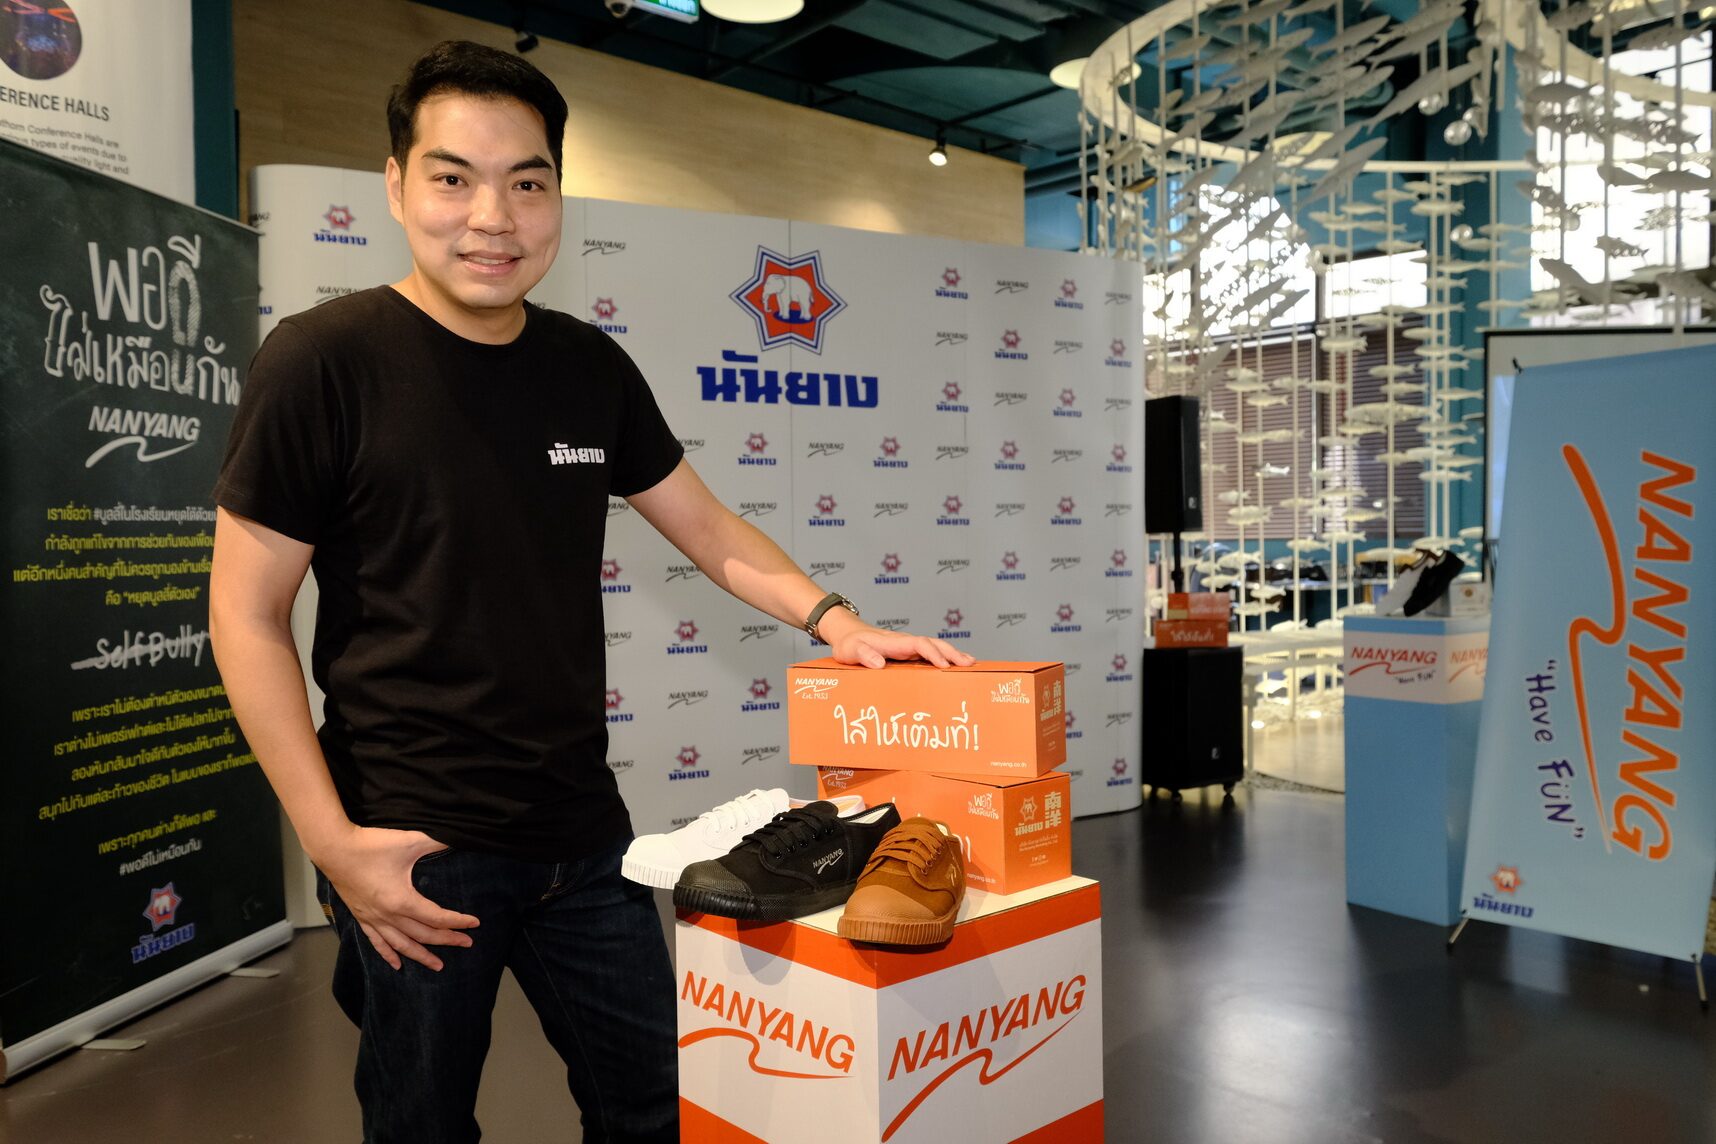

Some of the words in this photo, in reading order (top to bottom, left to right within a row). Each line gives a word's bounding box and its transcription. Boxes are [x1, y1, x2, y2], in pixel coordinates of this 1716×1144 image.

[65, 97, 110, 122] HALLS
[28, 124, 82, 140] Conference
[85, 132, 104, 146] Halls
[106, 138, 119, 149] are
[31, 138, 58, 151] types
[59, 142, 69, 152] of
[71, 144, 100, 157] events
[101, 148, 116, 160] due
[118, 153, 128, 162] to
[113, 165, 129, 176] and
[583, 239, 626, 250] NANYANG
[40, 284, 242, 406] ไม่เหมือนกัน
[697, 350, 878, 408] นันยาง
[88, 405, 201, 441] NANYANG
[548, 443, 605, 465] นันยาง
[808, 442, 845, 451] NANYANG
[739, 502, 778, 511] NANYANG
[811, 561, 846, 570] NANYANG
[741, 624, 779, 634] NANYANG
[1351, 646, 1438, 665] NANYANG
[1607, 449, 1698, 861] NANYANG
[795, 678, 839, 686] NANYANG
[668, 690, 709, 701] NANYANG
[834, 701, 980, 751] ใส่ให้เต็มที่!
[812, 848, 844, 868] NANYANG
[681, 970, 856, 1074] NANYANG
[887, 974, 1087, 1081] NANYANG
